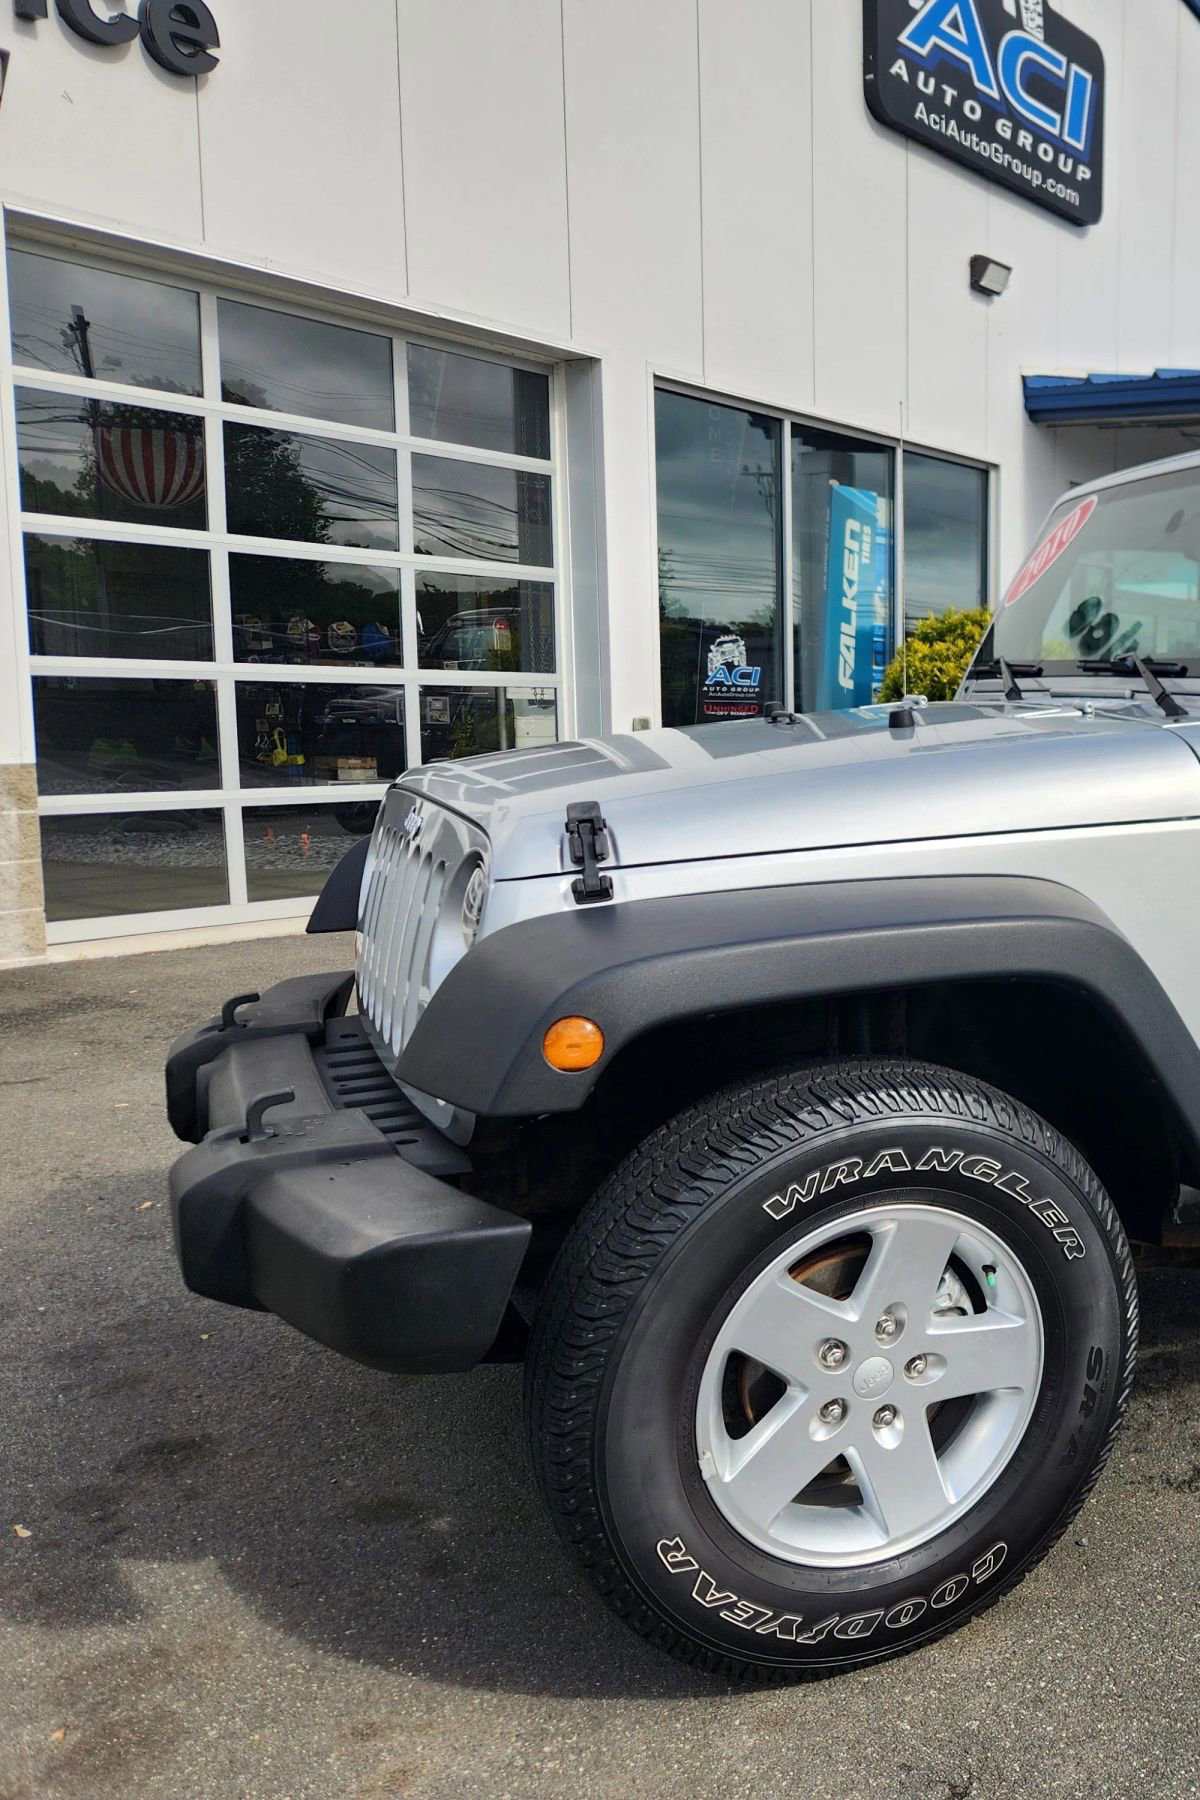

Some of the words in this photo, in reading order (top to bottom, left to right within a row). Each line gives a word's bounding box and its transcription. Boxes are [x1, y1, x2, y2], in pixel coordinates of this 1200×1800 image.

[889, 58, 982, 121] AUTO
[995, 118, 1092, 182] GROUP
[897, 0, 1092, 151] ACI
[913, 102, 1080, 206] AciAutoGroup.com
[861, 525, 872, 564] TIRES
[838, 518, 861, 690] FALKEN
[704, 665, 761, 686] ACI
[762, 1147, 1087, 1261] WRANGLER
[859, 1364, 888, 1392] Jeep
[656, 1535, 1009, 1645] GOODYEAR
